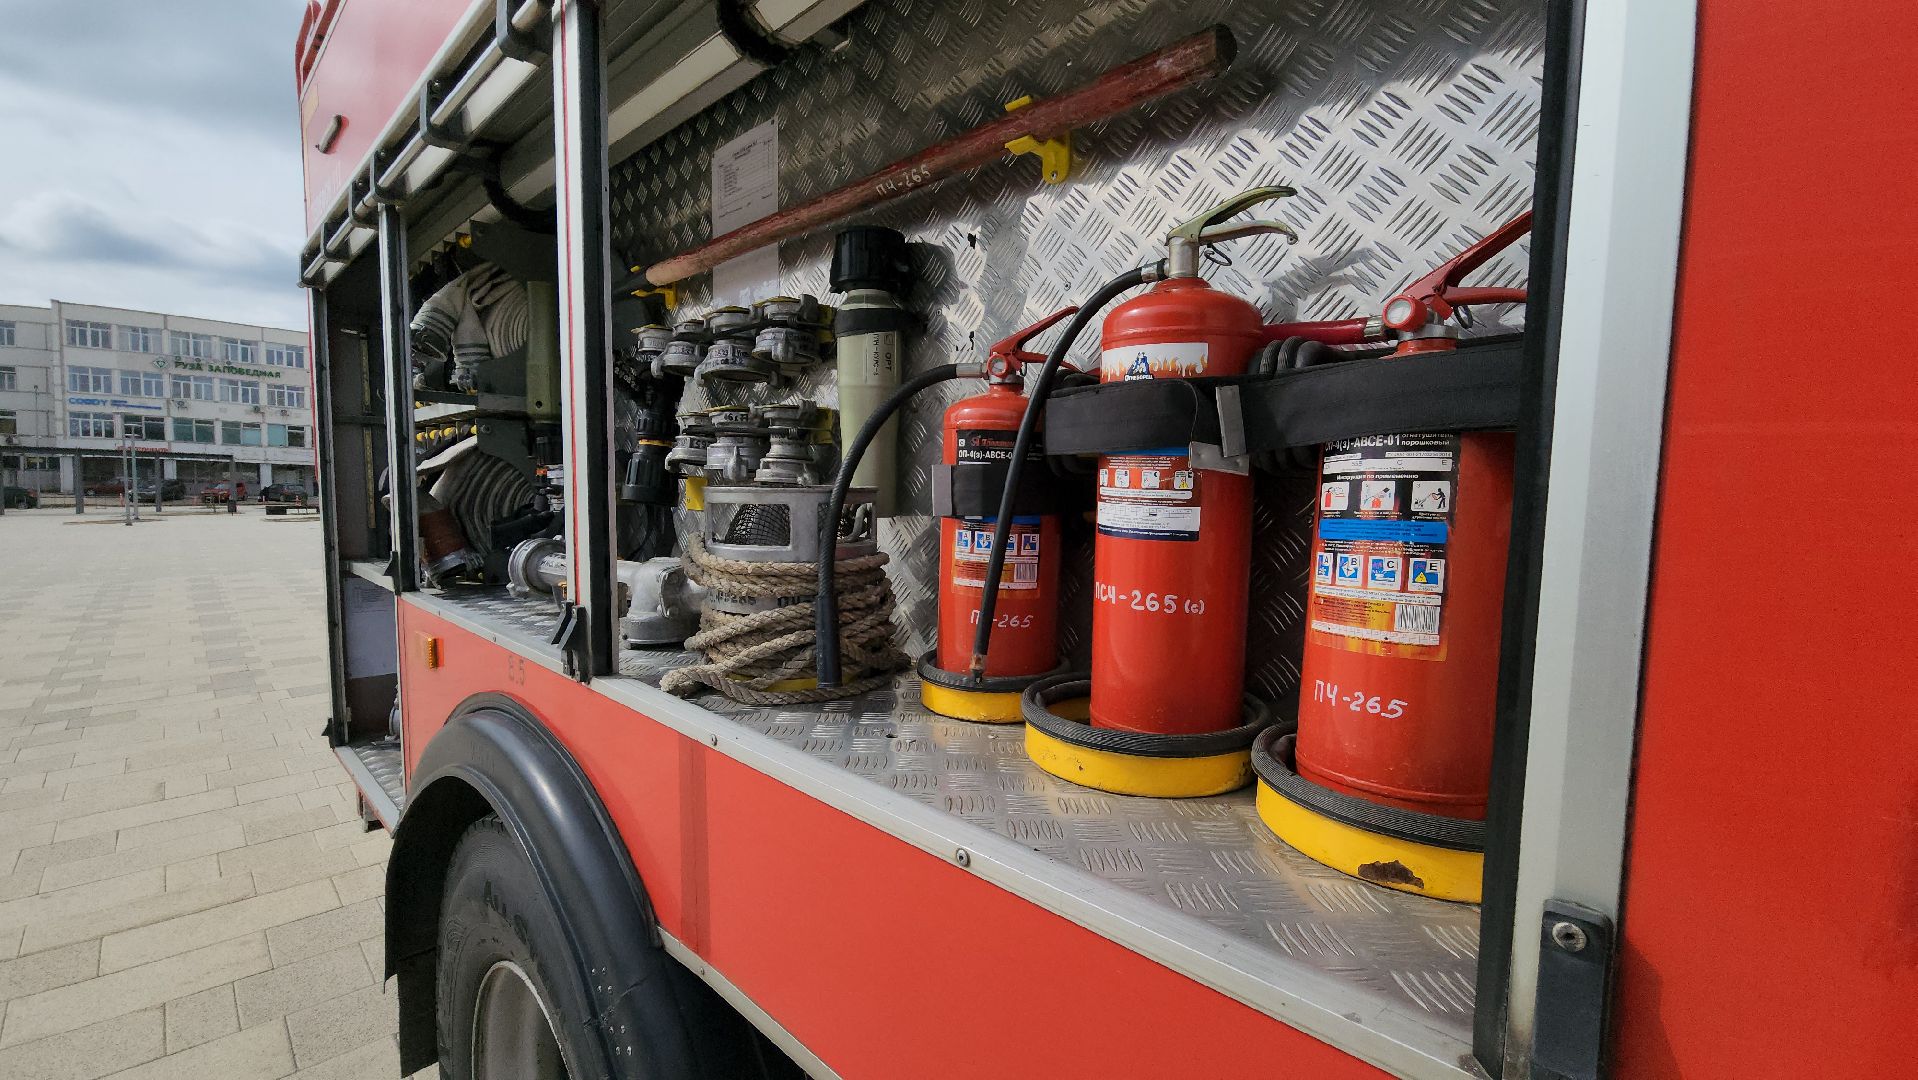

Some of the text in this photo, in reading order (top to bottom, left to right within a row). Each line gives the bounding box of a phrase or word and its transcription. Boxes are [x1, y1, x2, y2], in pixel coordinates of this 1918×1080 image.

[207, 364, 281, 378] ЗАПОВЕДНАЯ
[958, 449, 1013, 460] ОП-4(з)-АВСЕ-0
[1323, 555, 1329, 564] A
[1350, 557, 1358, 566] B
[1386, 560, 1396, 570] C
[1429, 562, 1438, 572] E
[1095, 581, 1178, 614] ПСЧ-265
[970, 609, 1034, 628] П-265
[1314, 679, 1408, 719] ПЧ-265
